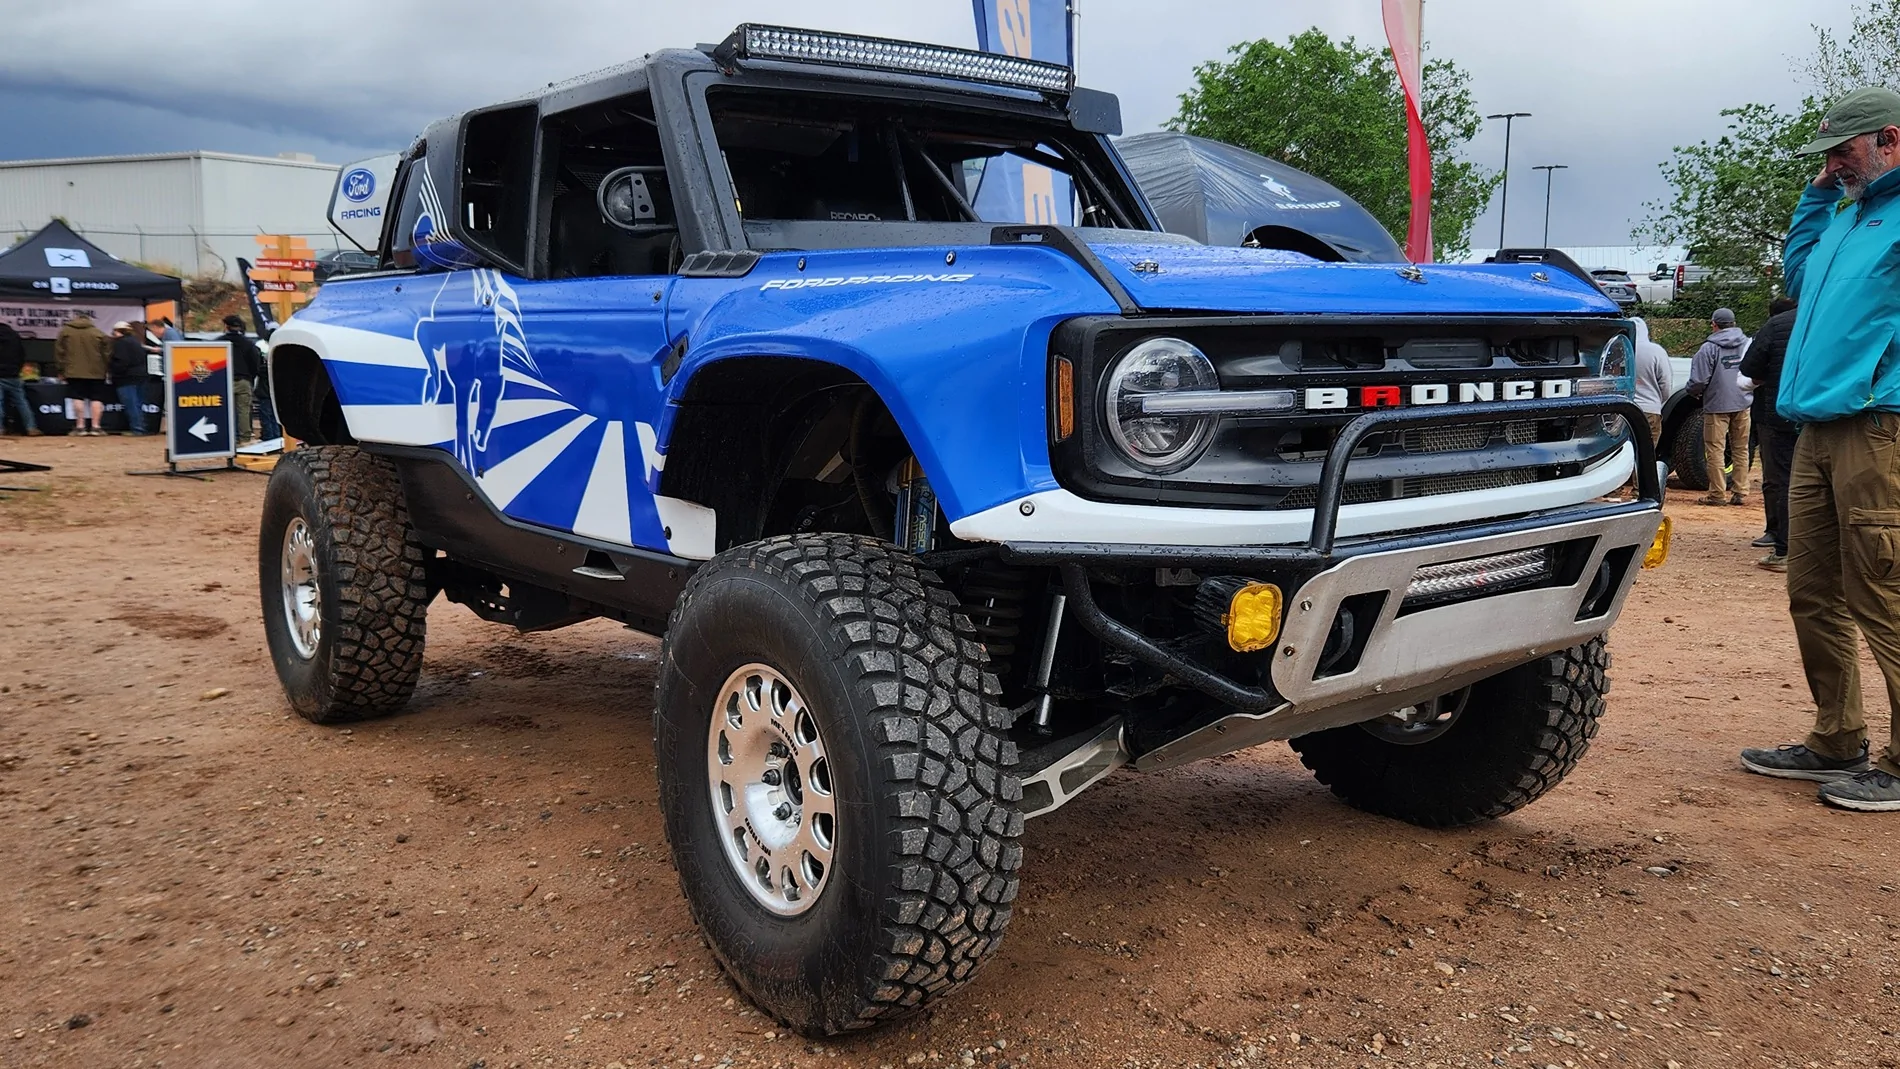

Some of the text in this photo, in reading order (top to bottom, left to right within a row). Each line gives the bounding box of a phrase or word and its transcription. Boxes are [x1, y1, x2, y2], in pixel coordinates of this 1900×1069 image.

[348, 174, 370, 197] Ford
[341, 207, 381, 220] RACING
[178, 395, 223, 407] DRIVE
[1304, 379, 1572, 409] BRONCO
[770, 718, 799, 756] METHOD
